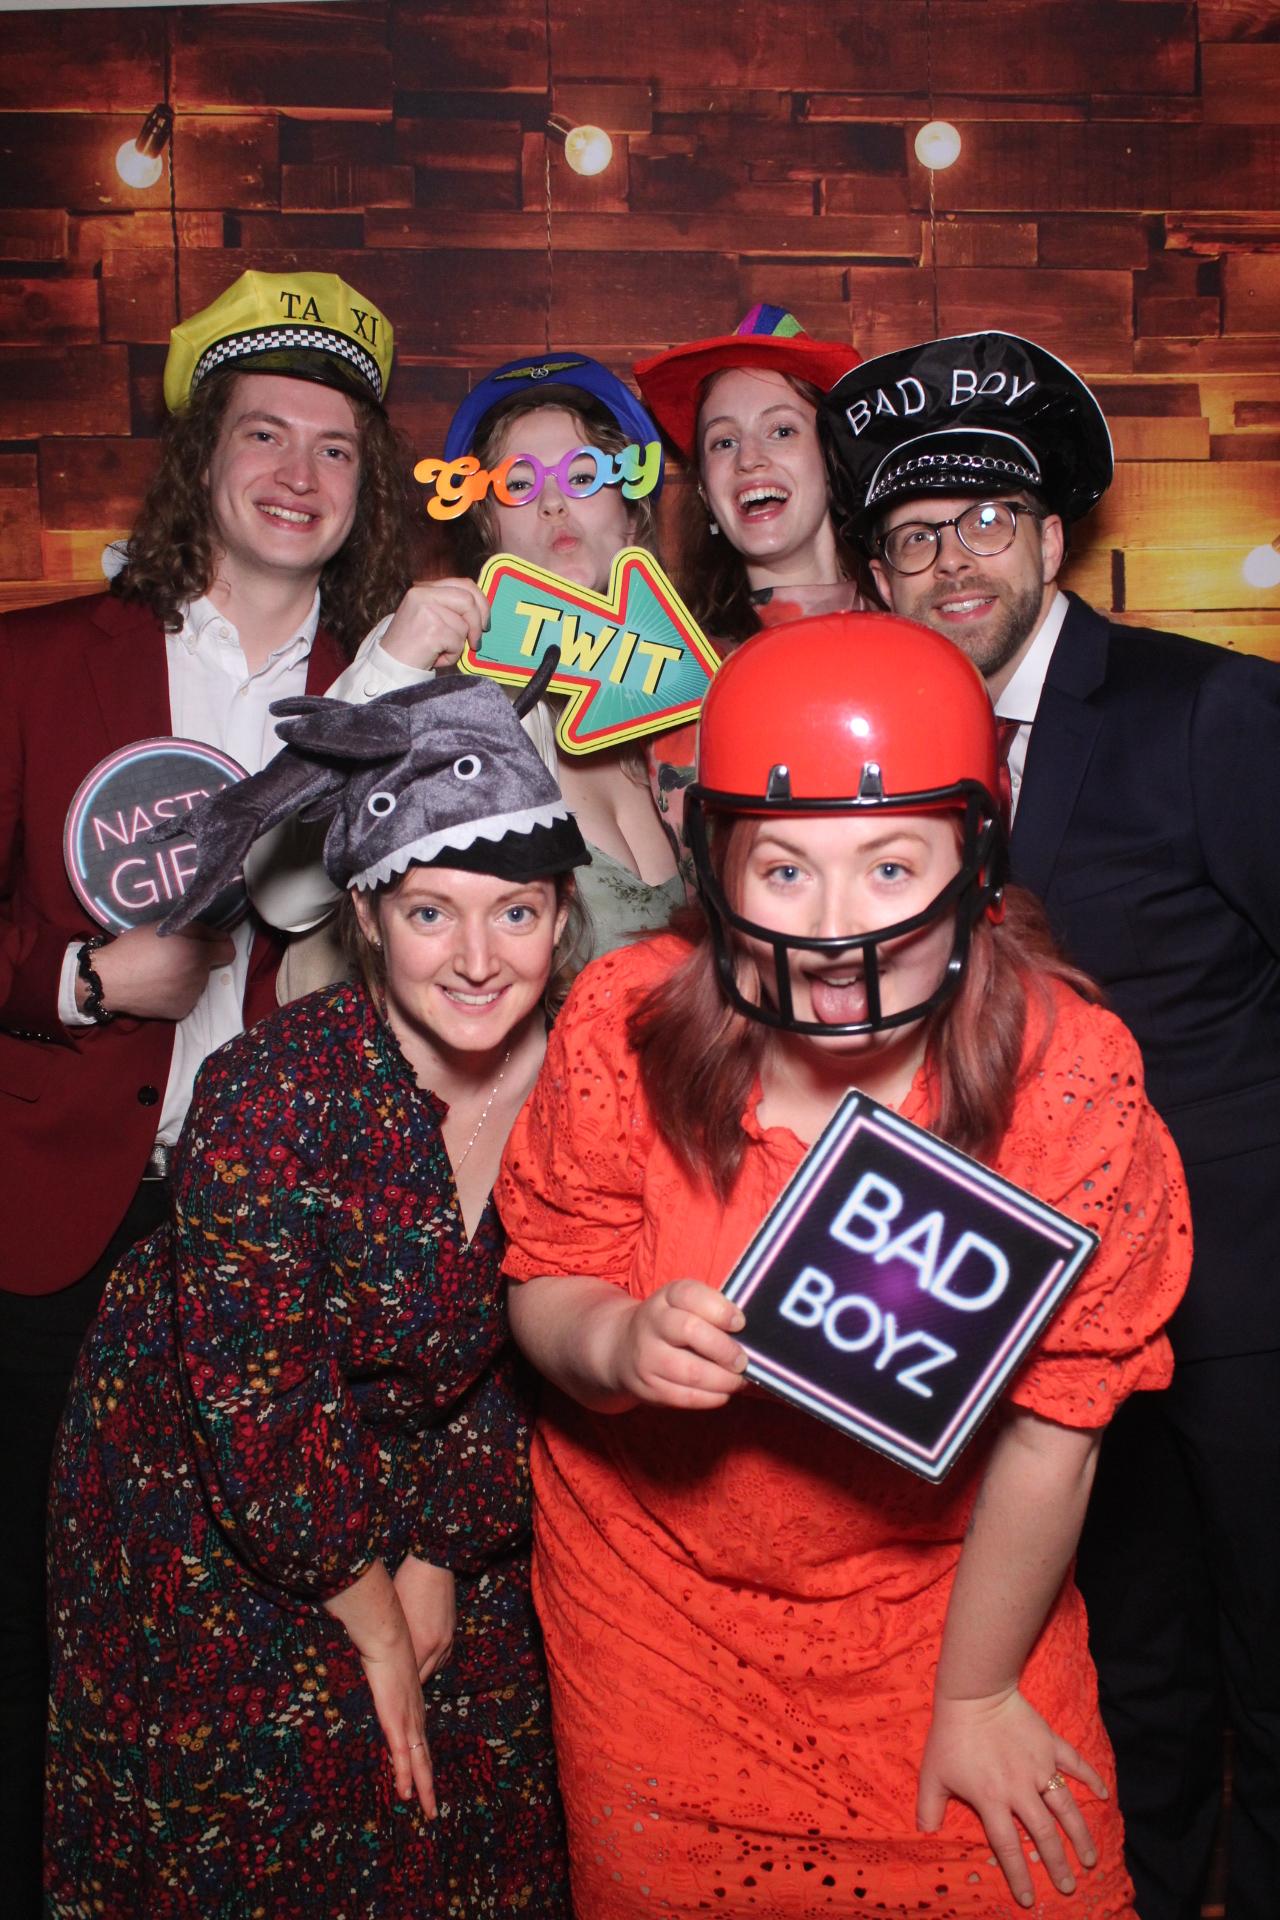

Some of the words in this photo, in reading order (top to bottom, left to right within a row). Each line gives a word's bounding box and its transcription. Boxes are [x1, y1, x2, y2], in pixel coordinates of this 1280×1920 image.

[845, 377, 926, 436] BAD
[950, 369, 1036, 406] BOY
[514, 600, 684, 696] TWIT
[92, 784, 227, 851] NAST
[110, 844, 243, 909] GIR
[829, 1171, 1010, 1312] BAD
[779, 1265, 958, 1399] BOYZ
